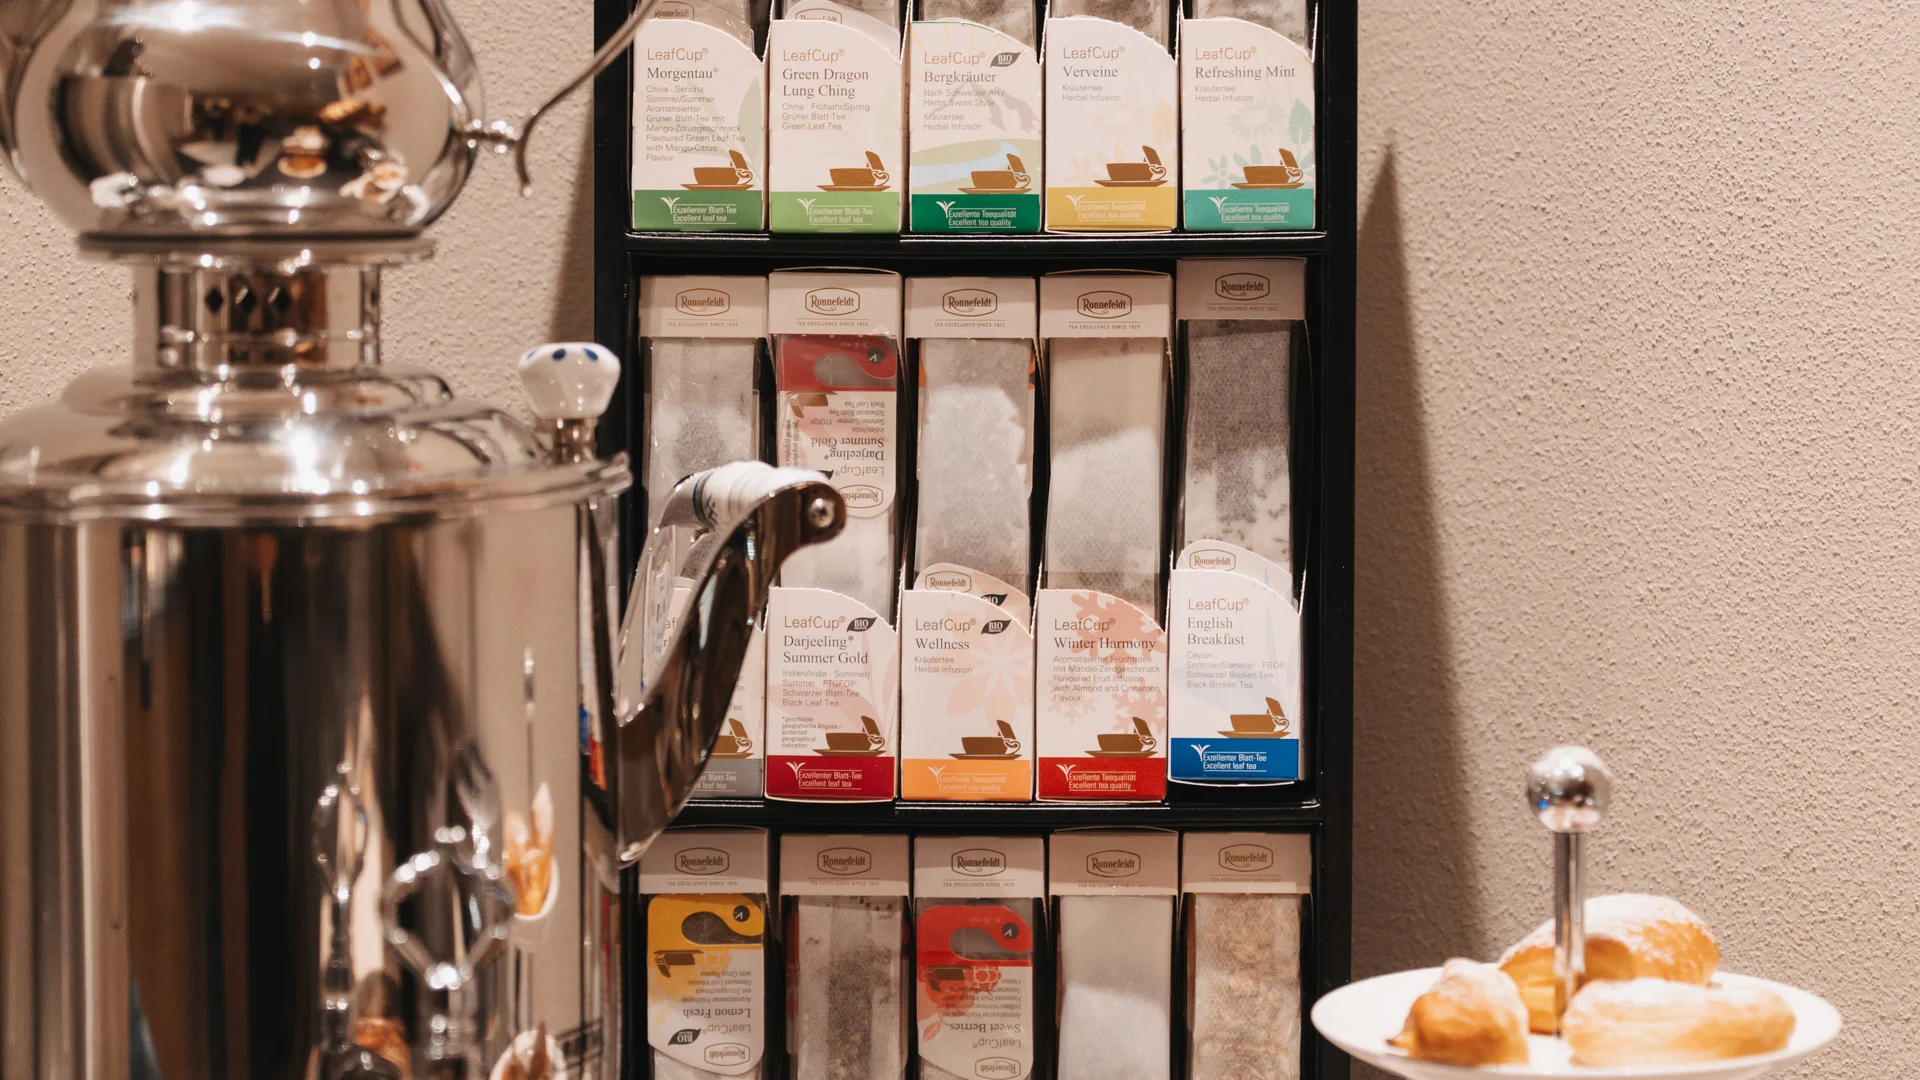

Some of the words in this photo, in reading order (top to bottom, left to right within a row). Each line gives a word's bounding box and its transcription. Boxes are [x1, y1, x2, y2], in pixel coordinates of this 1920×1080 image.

[647, 48, 709, 62] LeafCup®
[783, 49, 845, 63] LeafCup®
[1064, 46, 1125, 60] LeafCup®
[1195, 46, 1257, 61] LeafCup®
[924, 52, 986, 66] LeafCup®
[998, 55, 1012, 63] BIO
[647, 67, 718, 81] Morgentau®
[783, 68, 819, 80] Green
[824, 68, 869, 83] Dragon
[1063, 66, 1118, 78] Verveine
[1195, 66, 1262, 80] Refreshing
[1266, 66, 1295, 77] Mint
[924, 71, 996, 85] Bergkräuter
[783, 85, 814, 98] Lung
[818, 85, 855, 98] Ching
[1063, 84, 1103, 92] Kräutertee
[924, 89, 943, 97] Nach
[945, 89, 986, 97] Schweizer
[988, 89, 1005, 97] Art/
[646, 95, 715, 103] Sommer/Summer
[1195, 94, 1220, 102] Herbal
[1223, 94, 1254, 102] Infusion
[782, 103, 804, 111] China
[812, 103, 870, 112] Frühjahr/Spring
[924, 99, 948, 107] Herbs
[950, 99, 972, 107] Swiss
[975, 99, 994, 107] Style
[646, 114, 672, 122] Grüner
[675, 114, 709, 122] Blatt-Tee
[712, 114, 724, 122] mit
[924, 113, 964, 121] Kräutertee
[646, 125, 740, 133] Mango-Zitrusgeschmack
[924, 123, 949, 131] Herbal
[951, 123, 982, 131] Infusion
[646, 134, 683, 142] Flavoured
[686, 134, 709, 142] Green
[712, 134, 728, 142] Leaf
[731, 134, 745, 142] Tea
[646, 144, 663, 152] with
[665, 144, 717, 152] Mango-Citrus
[673, 206, 706, 214] Exzellenter
[709, 206, 736, 214] Blatt-Tee
[949, 210, 980, 218] Exzellente
[982, 210, 1016, 219] Teequalität
[673, 214, 700, 222] Excellent
[702, 214, 714, 222] leaf
[717, 214, 727, 222] tea
[949, 218, 976, 226] Excellent
[978, 218, 988, 226] tea
[991, 218, 1011, 226] quality
[1220, 280, 1264, 296] Ronnefeldt
[681, 296, 724, 311] Ronnefeldt
[811, 295, 854, 311] Ronnefeldt
[948, 296, 992, 313] Ronnefeldt
[1083, 298, 1126, 315] Ronnefeldt
[812, 438, 837, 447] Gold
[840, 438, 884, 447] Summer
[1195, 555, 1231, 567] Ronnefeldt
[930, 577, 966, 590] Ronnefeldt
[1188, 598, 1250, 613] LeafCup®
[784, 616, 846, 631] LeafCup®
[854, 619, 868, 627] BIO
[916, 619, 976, 633] LeafCup®
[989, 622, 1003, 630] BIO
[1054, 618, 1116, 632] LeafCup®
[1188, 617, 1233, 631] English
[915, 638, 969, 649] Wellness
[1187, 634, 1244, 645] Breakfast
[1054, 638, 1096, 649] Winter
[1100, 638, 1156, 651] Harmony
[783, 652, 834, 663] Summer
[839, 652, 868, 663] Gold
[915, 656, 954, 664] Kräutertee
[1187, 651, 1213, 660] Ceylon
[1054, 665, 1066, 673] mit
[1068, 665, 1160, 673] Mandel-Zimtgeschmack
[1187, 661, 1255, 669] Sommer/Summer
[1263, 661, 1285, 669] FBOP
[1187, 671, 1227, 679] Schwarzer
[1230, 671, 1257, 679] Broken
[1259, 671, 1273, 679] Tee
[1054, 684, 1070, 692] with
[1073, 684, 1102, 692] Almond
[1104, 684, 1118, 692] and
[1121, 684, 1160, 692] Cinnamon
[1187, 681, 1207, 689] Black
[1210, 681, 1237, 689] Broken
[1239, 681, 1253, 689] Tea
[783, 699, 802, 707] Black
[805, 699, 823, 707] Leaf
[825, 699, 839, 707] Tea
[1203, 754, 1236, 762] Exzellenter
[1239, 754, 1267, 762] Blatt-Tee
[1203, 762, 1230, 770] Excellent
[1233, 762, 1244, 770] leaf
[1246, 762, 1256, 770] tea
[708, 774, 736, 782] Blatt-Tee
[1069, 774, 1100, 782] Exzellente
[1102, 774, 1136, 782] Teequalität
[1069, 782, 1096, 790] Excellent
[1099, 782, 1108, 790] tea
[1110, 782, 1131, 790] quality
[680, 855, 723, 871] Ronnefeldt
[822, 855, 865, 870] Ronnefeldt
[957, 856, 1000, 872] Ronnefeldt
[1224, 852, 1267, 867] Ronnefeldt
[1092, 858, 1134, 873] Ronnefeldt
[683, 1008, 710, 1017] Fresh
[715, 1008, 750, 1017] Lemon
[950, 1023, 986, 1032] Berries
[990, 1023, 1021, 1032] Sweet
[677, 1034, 693, 1043] BIO
[710, 1046, 746, 1060] Ronnefeldt
[980, 1061, 1017, 1074] Ronnefeldt
